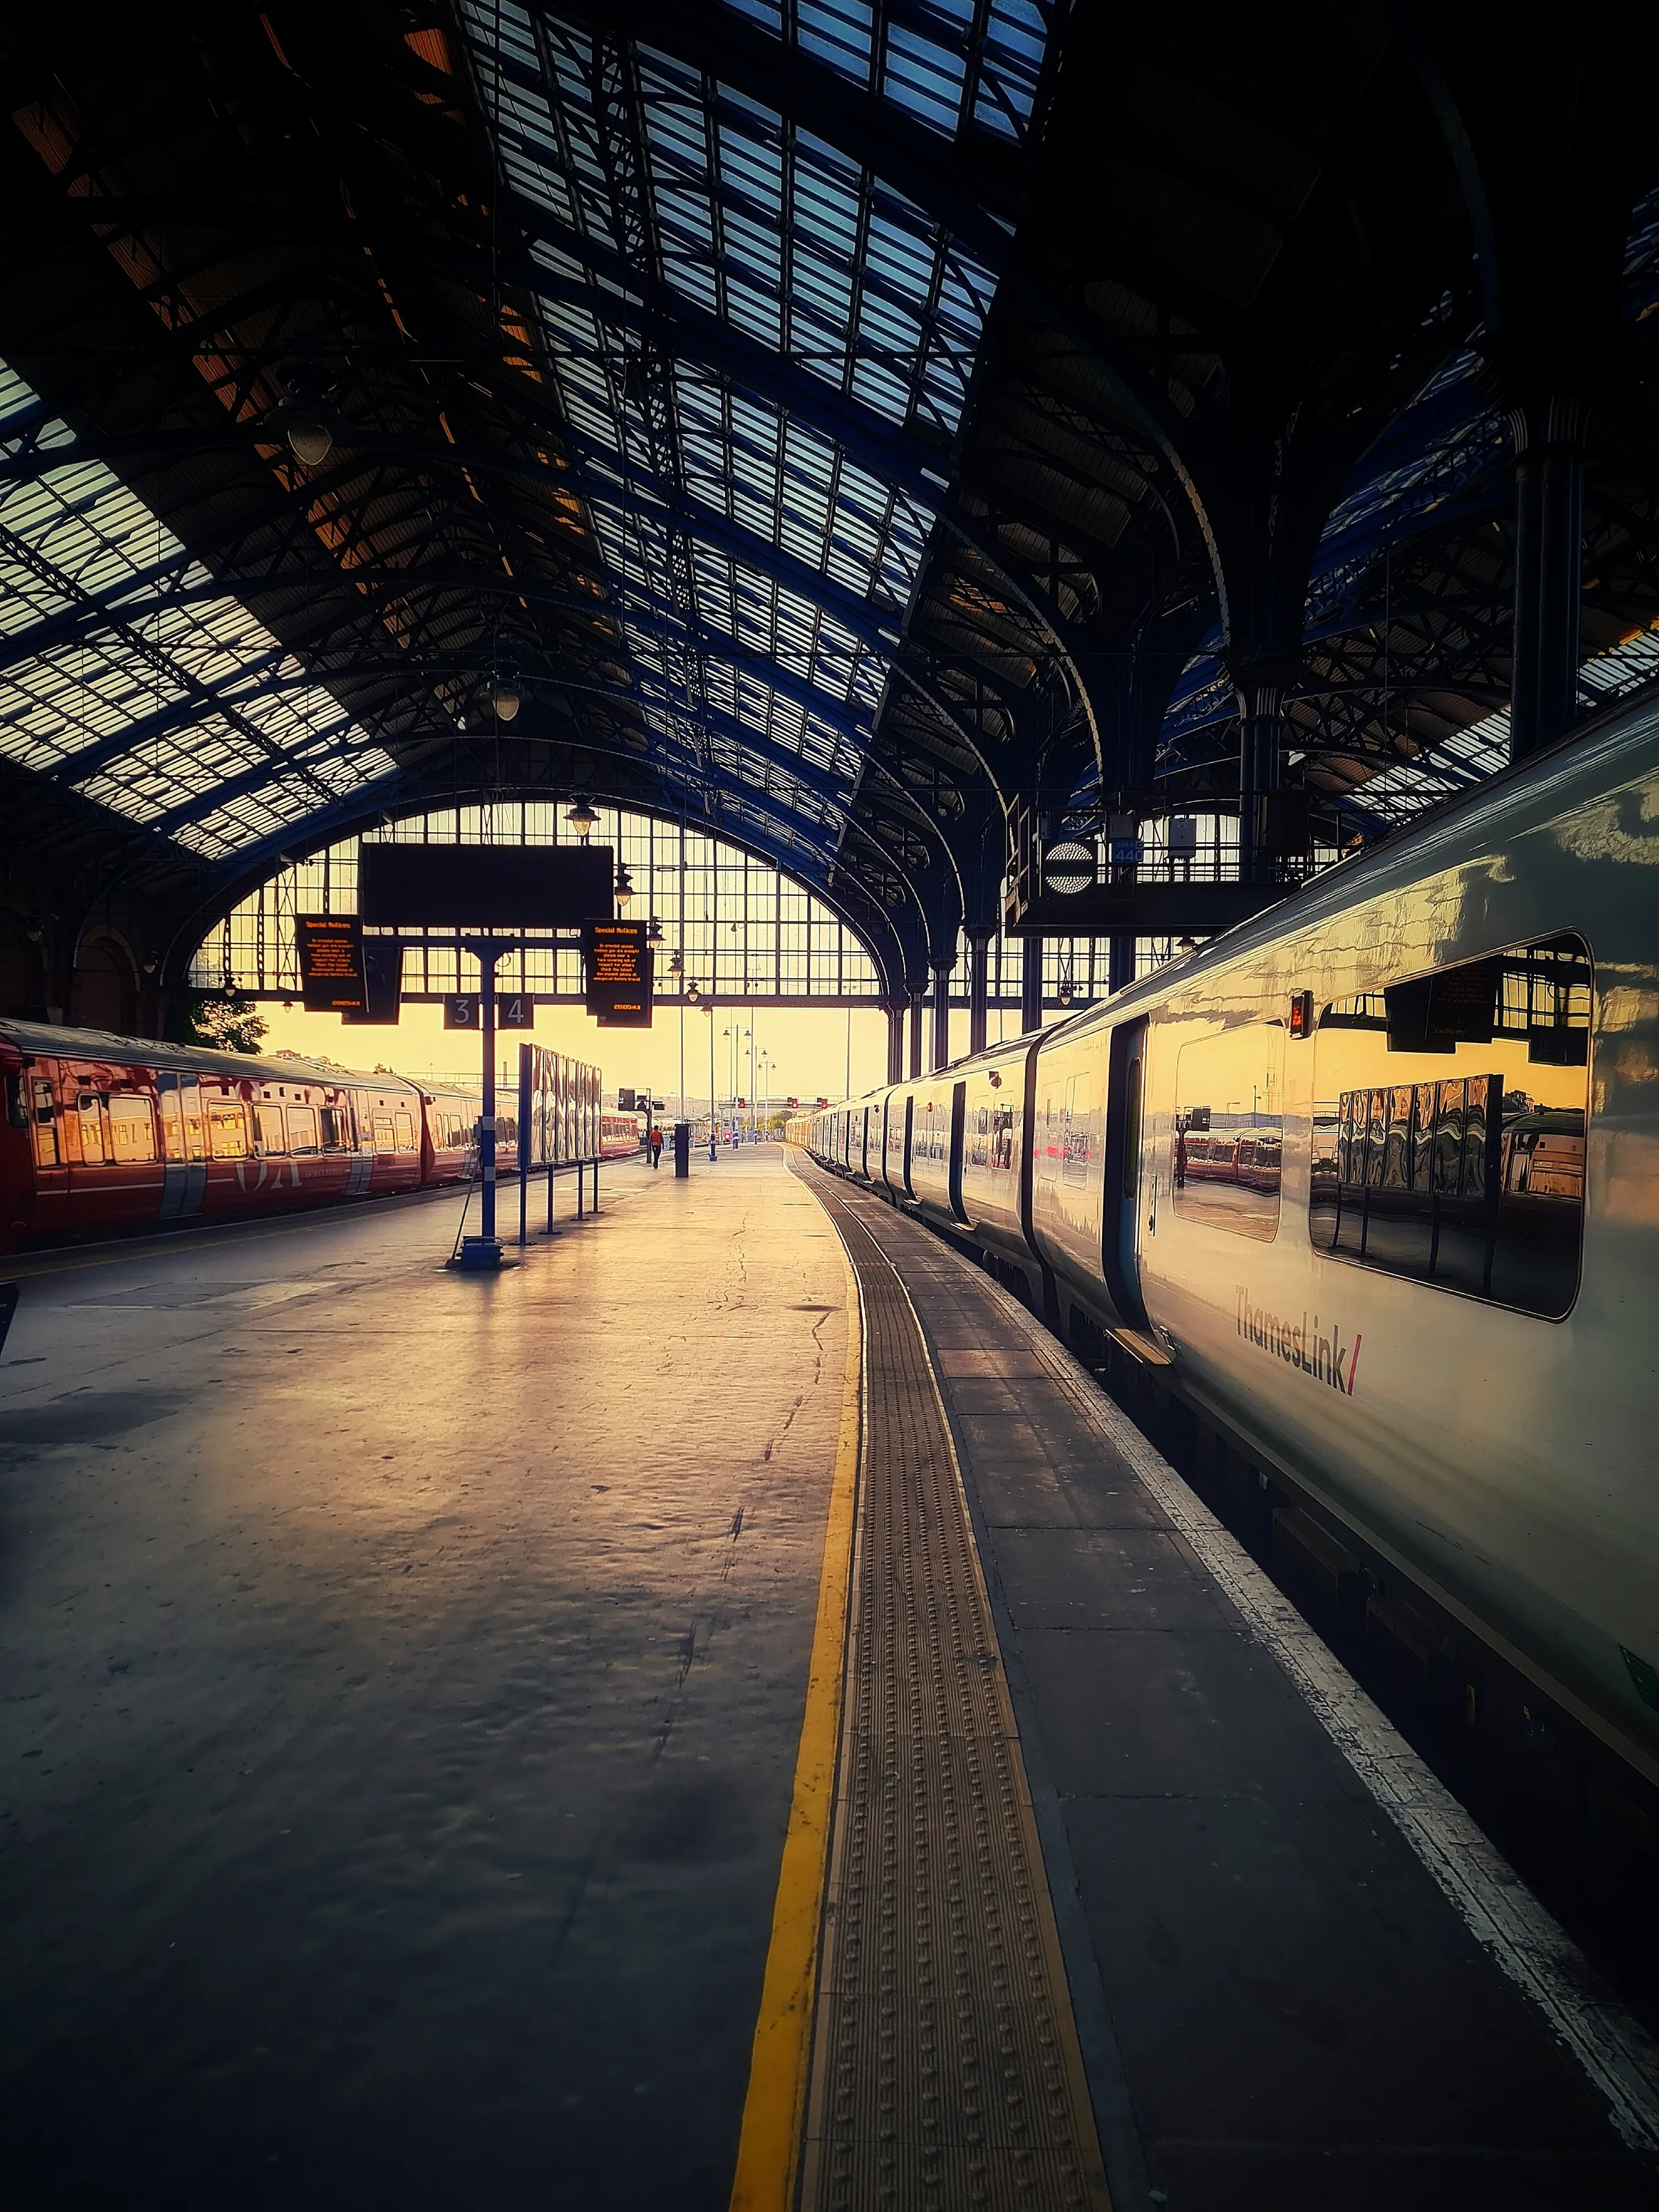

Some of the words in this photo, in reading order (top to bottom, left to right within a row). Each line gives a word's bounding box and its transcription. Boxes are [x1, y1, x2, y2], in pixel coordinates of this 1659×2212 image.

[1116, 850, 1143, 861] 440
[454, 999, 469, 1024] 3
[508, 999, 524, 1024] 4
